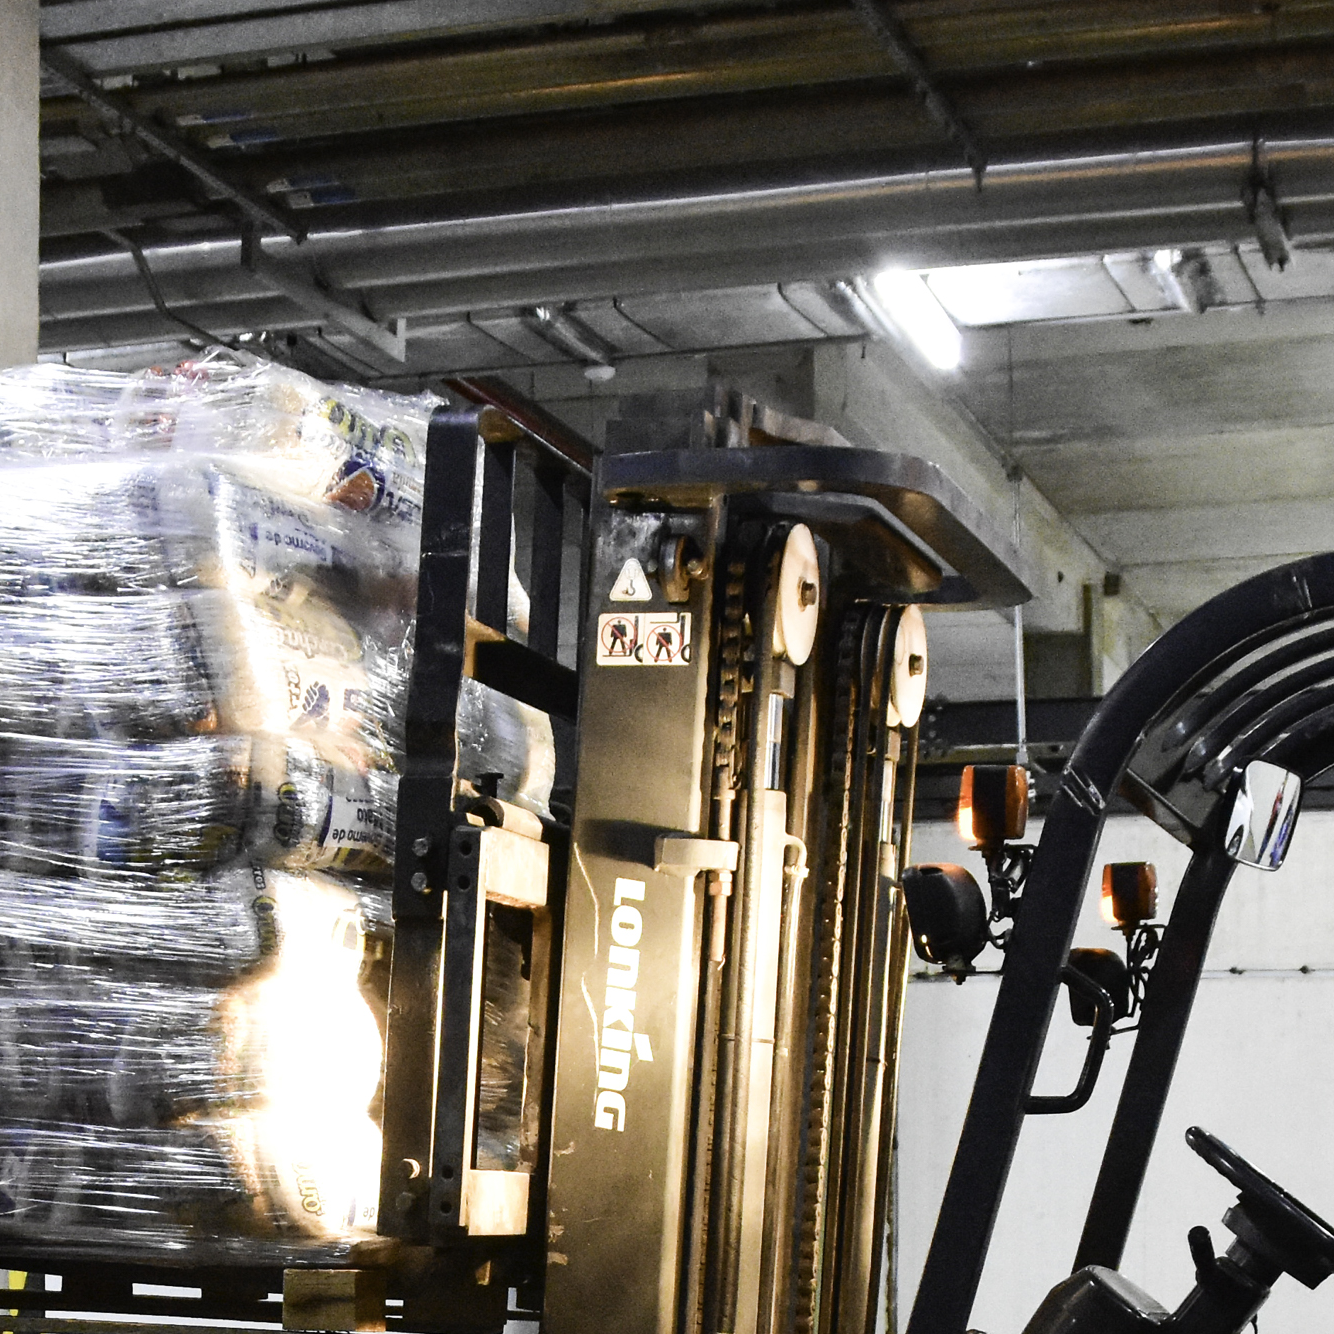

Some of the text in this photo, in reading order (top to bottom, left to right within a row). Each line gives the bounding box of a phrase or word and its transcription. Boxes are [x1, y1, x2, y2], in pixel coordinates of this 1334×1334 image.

[331, 827, 347, 844] de
[594, 877, 649, 1132] LONKING
[362, 1207, 376, 1221] de
